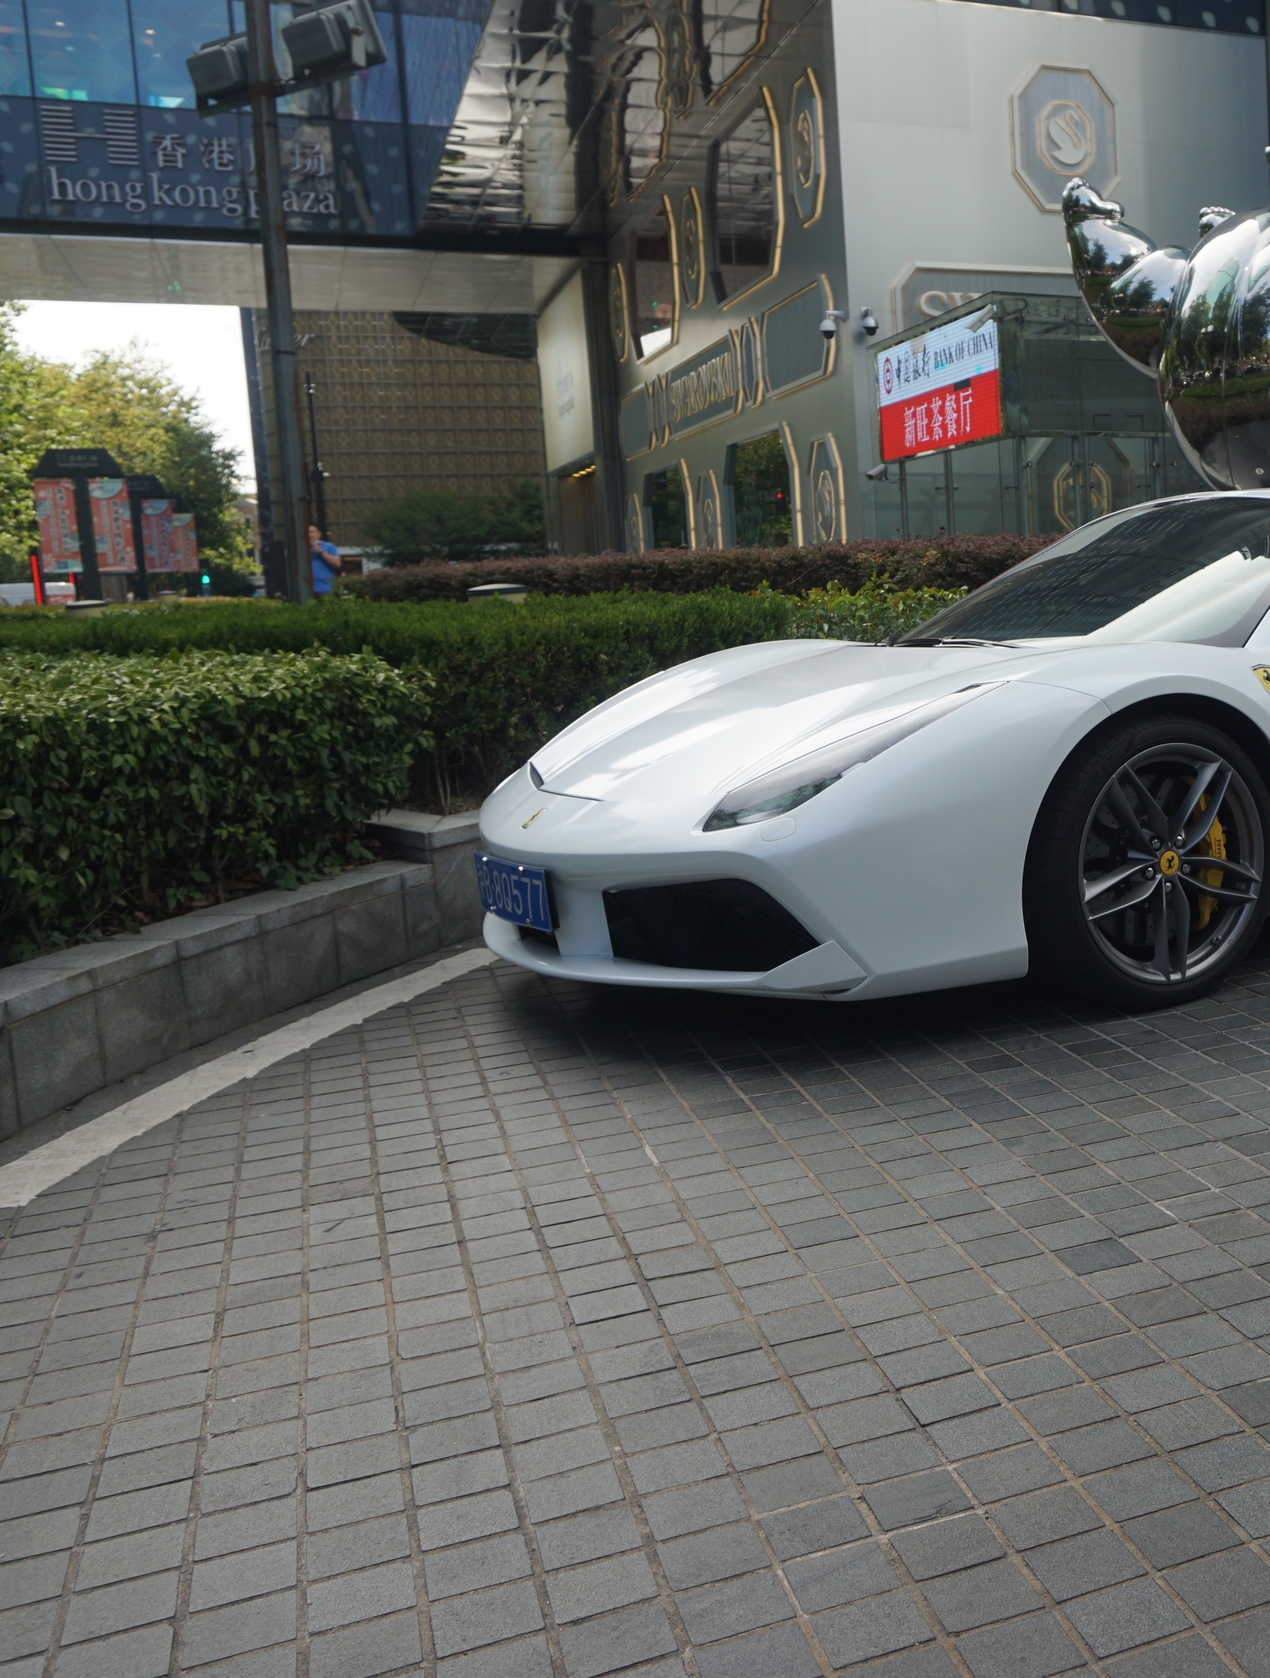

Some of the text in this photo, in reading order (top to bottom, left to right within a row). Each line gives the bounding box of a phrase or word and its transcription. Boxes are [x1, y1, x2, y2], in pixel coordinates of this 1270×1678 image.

[152, 133, 327, 177] 香港场
[934, 331, 994, 370] BANK OF CHINA
[904, 388, 973, 448] 新旺茶餐厅
